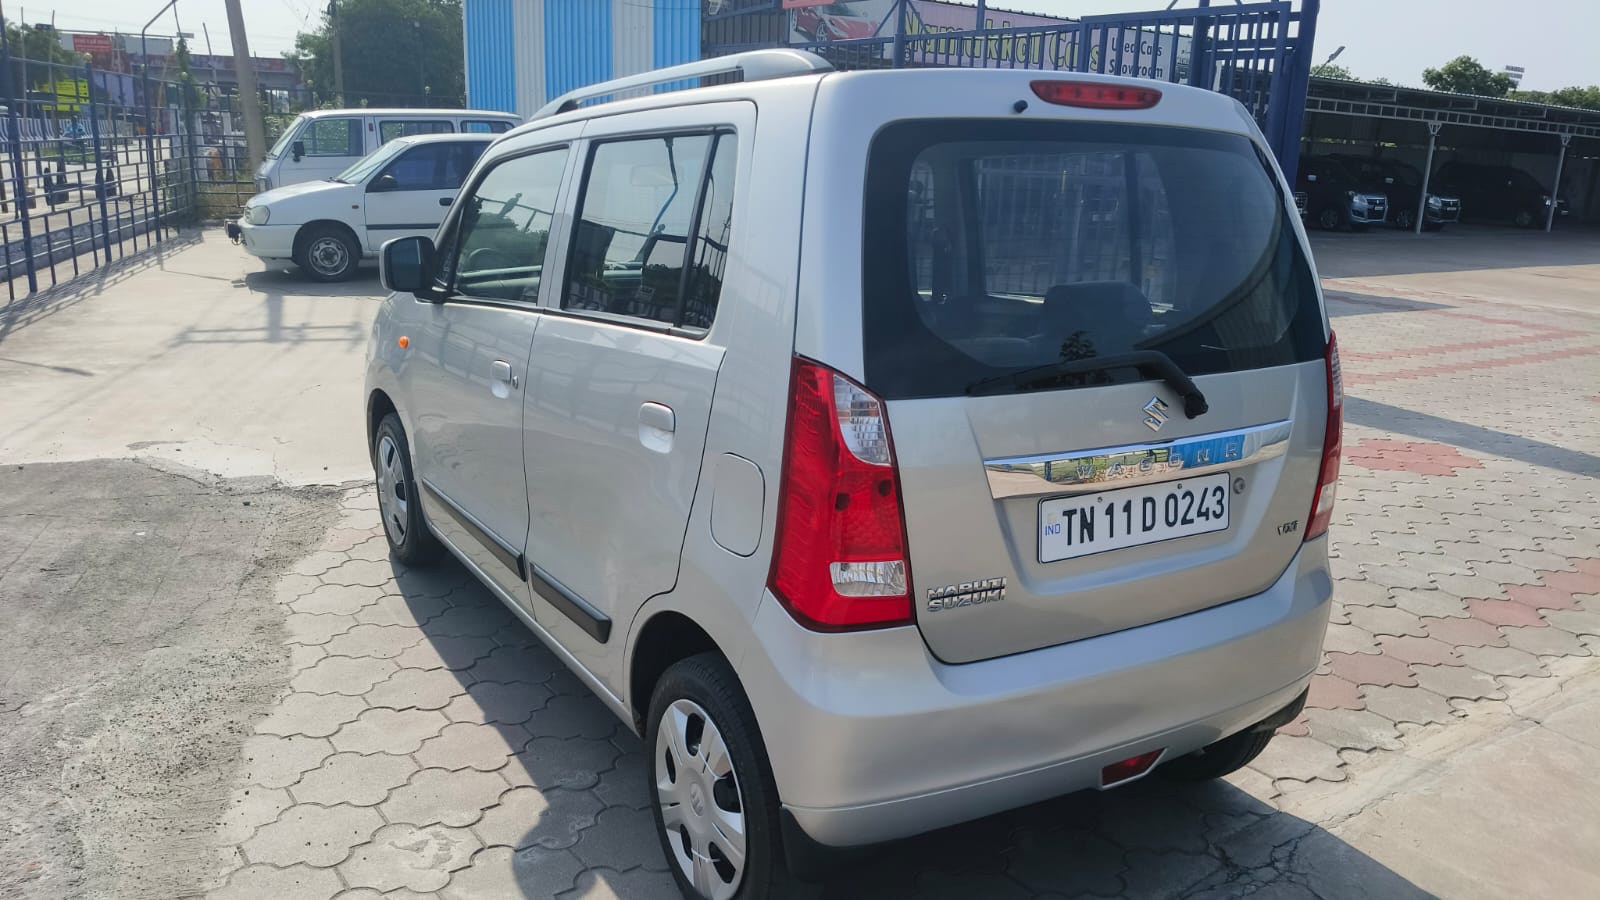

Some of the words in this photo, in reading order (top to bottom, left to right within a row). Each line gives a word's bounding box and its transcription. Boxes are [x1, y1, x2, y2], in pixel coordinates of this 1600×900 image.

[1048, 31, 1101, 71] Cas
[1140, 41, 1163, 56] Cas
[1062, 505, 1095, 546] TN
[1105, 500, 1132, 538] 11
[1142, 496, 1157, 533] D
[1164, 485, 1225, 528] 0243
[927, 576, 1008, 600] MARUTI
[927, 588, 1007, 612] SUZUKI
